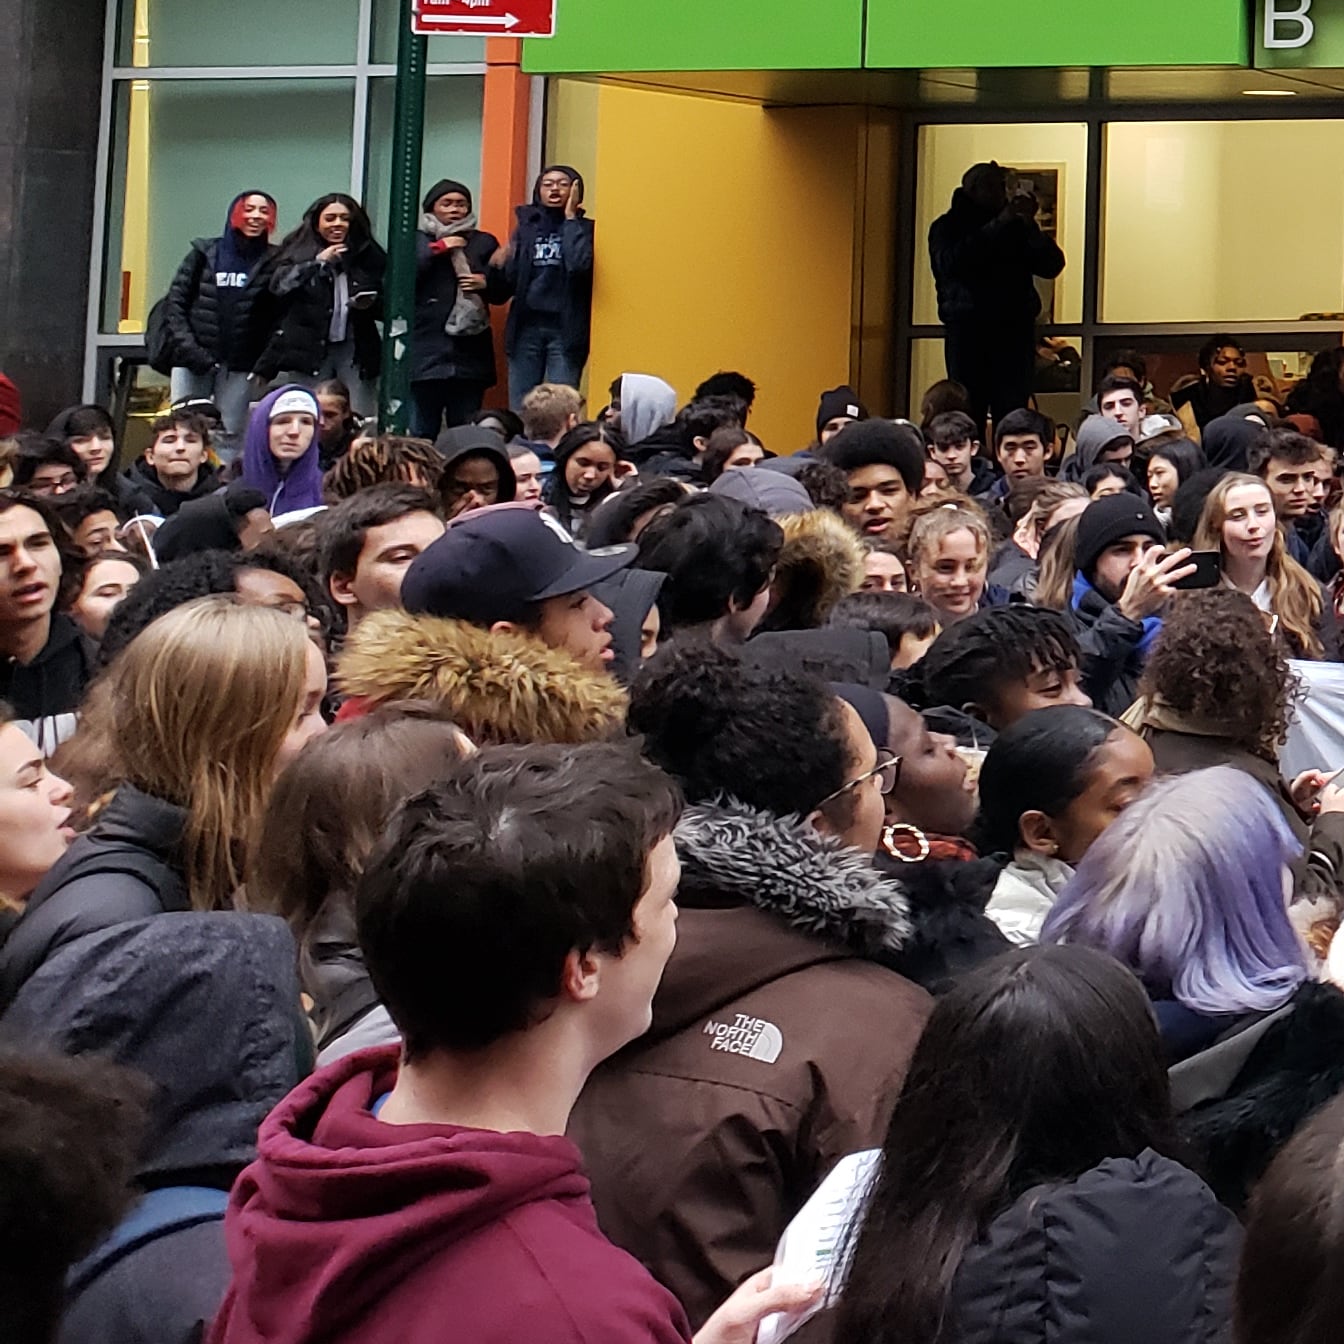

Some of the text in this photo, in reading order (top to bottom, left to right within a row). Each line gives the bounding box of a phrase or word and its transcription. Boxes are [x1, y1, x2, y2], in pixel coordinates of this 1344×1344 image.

[703, 1020, 761, 1045] NORTH
[734, 1013, 766, 1033] THE
[710, 1037, 753, 1056] FACE
